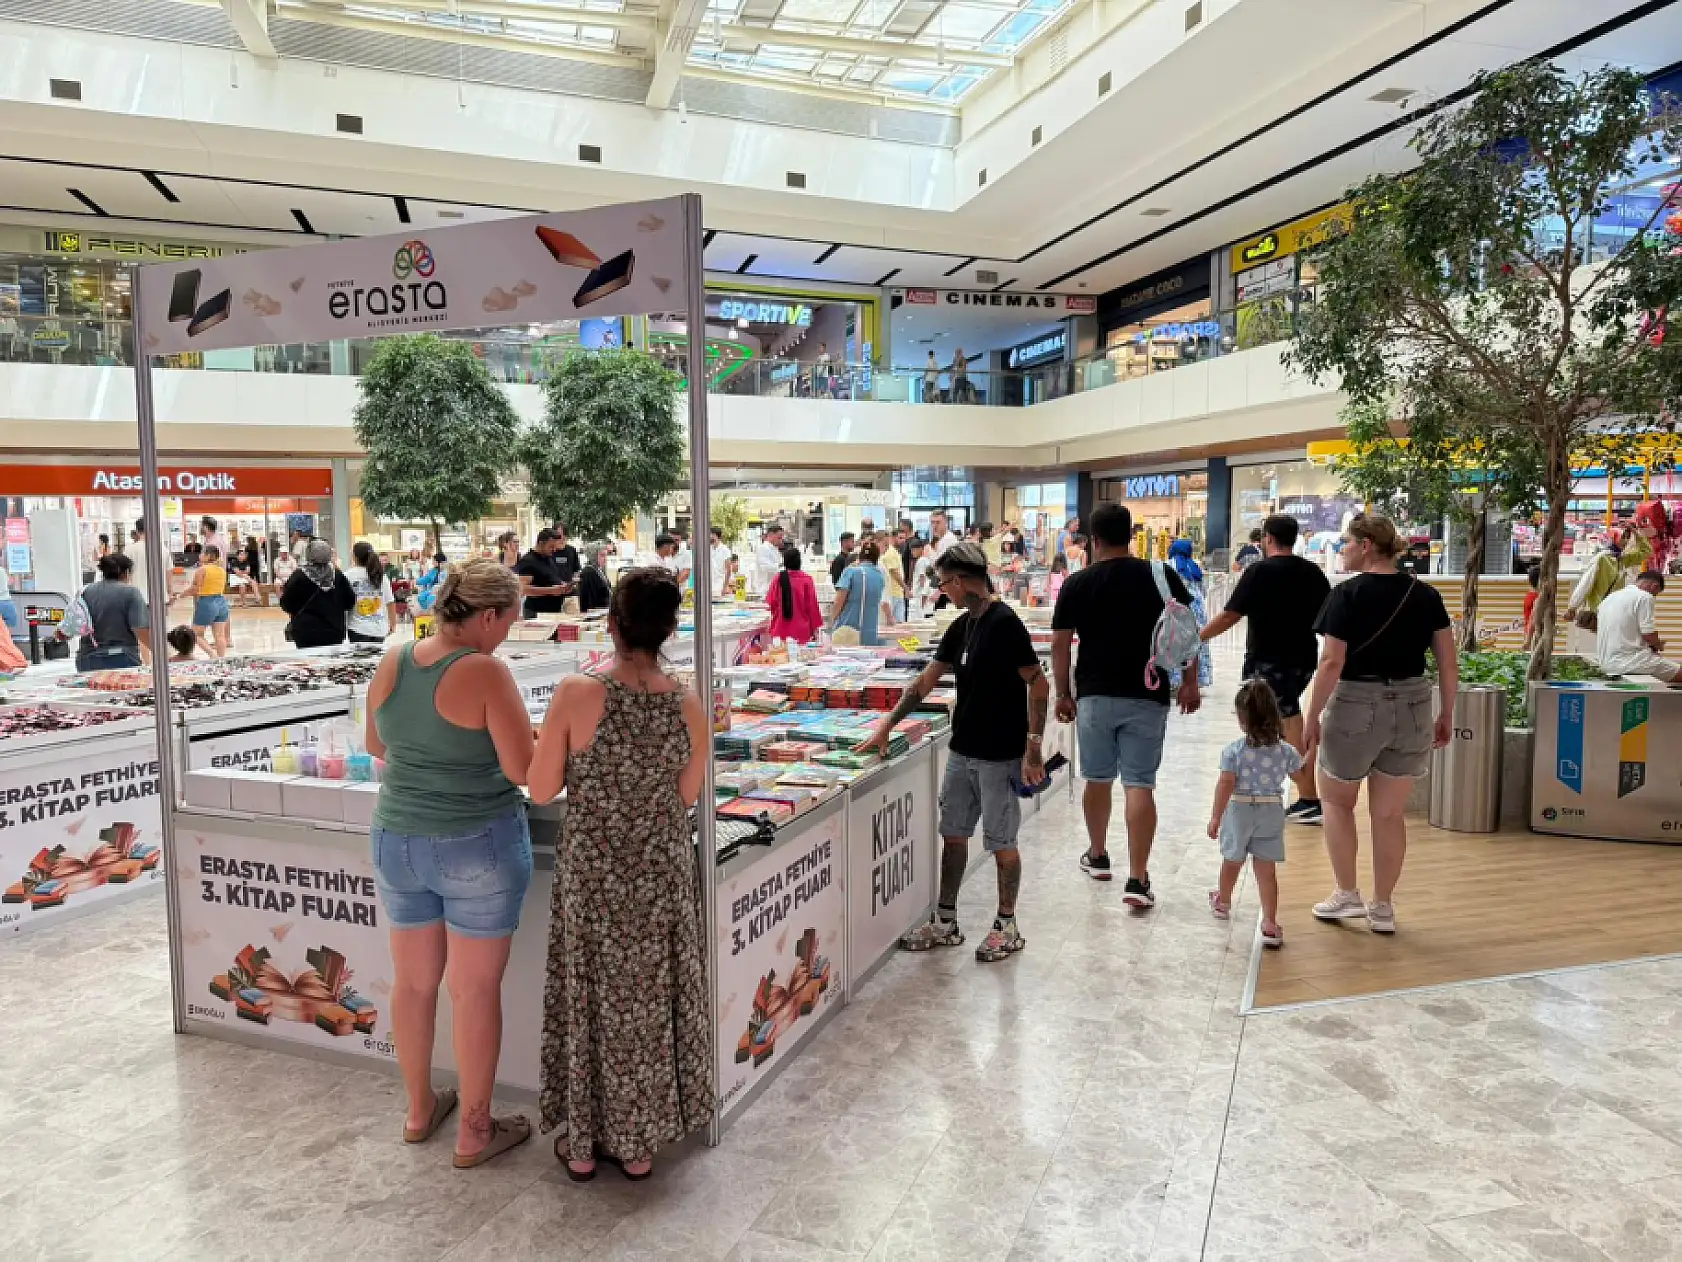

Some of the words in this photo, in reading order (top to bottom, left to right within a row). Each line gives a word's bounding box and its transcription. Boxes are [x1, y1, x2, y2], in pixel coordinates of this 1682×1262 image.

[719, 301, 812, 327] SPORTIVE
[945, 292, 1056, 308] CINEMAS
[92, 470, 172, 491] Atasn
[176, 471, 237, 494] Optik
[80, 761, 160, 789] FETHİYE
[211, 746, 271, 768] ERASTA
[21, 794, 91, 824] KİTAP
[95, 778, 161, 807] FUARI
[872, 790, 914, 862] KİTAP
[200, 854, 280, 885] ERASTA
[284, 866, 376, 898] FETHİYE
[731, 871, 783, 924] ERASTA
[785, 838, 831, 887] FETHİYE
[872, 839, 914, 917] FUARI
[201, 880, 222, 904] 3.
[226, 880, 296, 914] KİTAP
[301, 895, 377, 928] FUARI
[731, 928, 746, 956] 3.
[748, 893, 792, 944] KİTAP
[794, 863, 831, 911] FUARI
